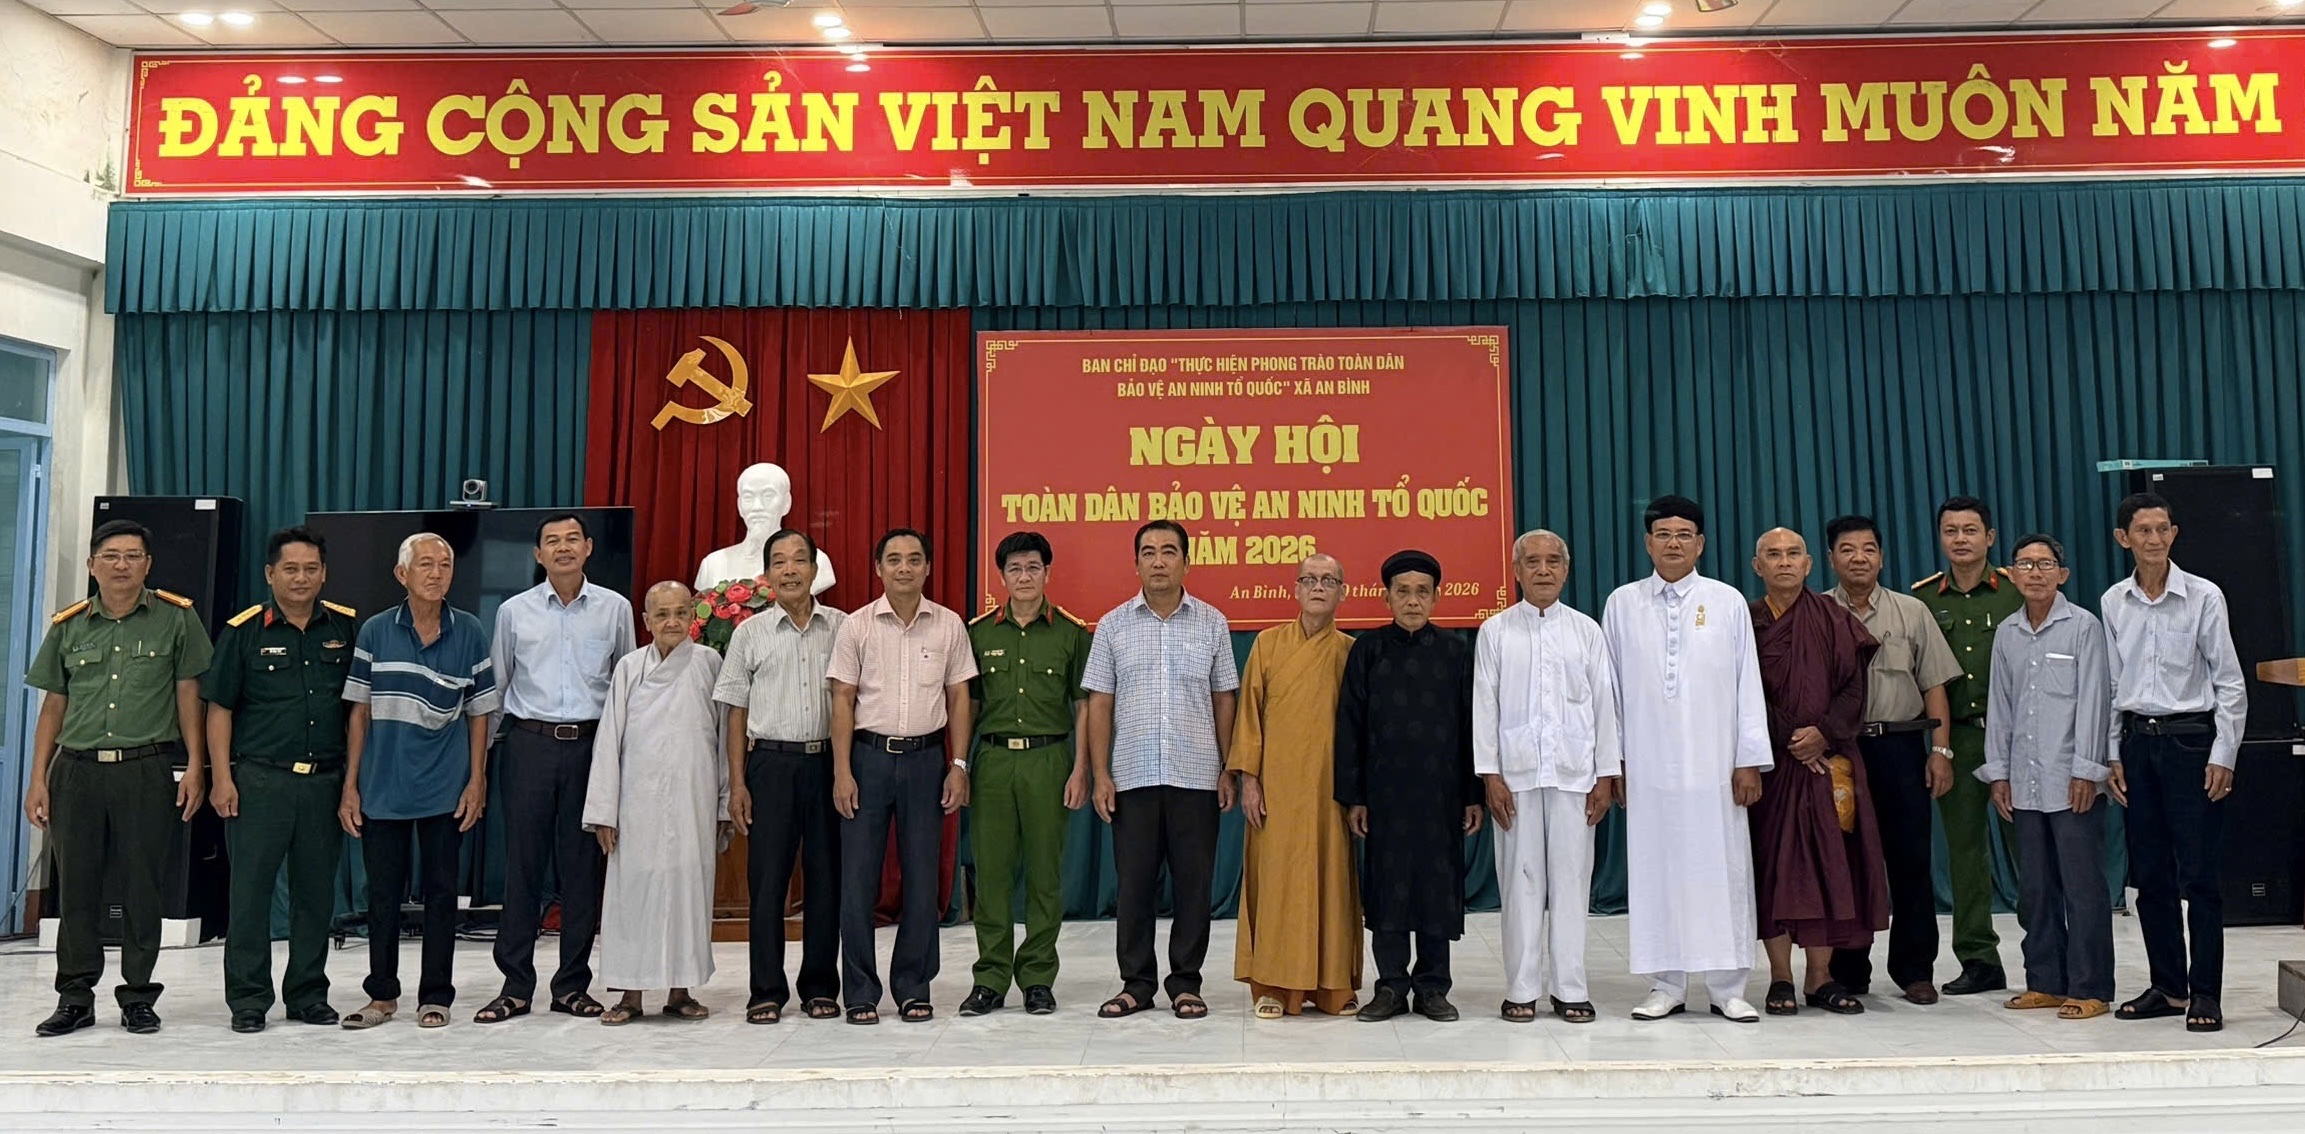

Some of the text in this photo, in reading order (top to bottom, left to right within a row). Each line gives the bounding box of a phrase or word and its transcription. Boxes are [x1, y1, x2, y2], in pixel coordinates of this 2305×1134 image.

[158, 58, 2283, 169] ĐẢNG CỘNG SẢN VIỆT NAM QUANG VINH MUÔN NĂM
[1082, 352, 1405, 376] BAN CHỈ ĐẠO "THỰC HIỆN PHONG TRÀO TOÀN DÂN
[1117, 376, 1370, 400] BẢO VỆ AN NINH TỔ QUỐC" XÃ AN BÌNH
[1129, 414, 1360, 474] NGÀY HỘI
[1001, 474, 1489, 527] TOÀN DÂN BẢO VỆ AN NINH TỔ QUỐC
[1245, 534, 1317, 565] 2026
[1229, 585, 1250, 599] An
[1253, 585, 1292, 600] Bình,
[1444, 582, 1480, 596] 2026
